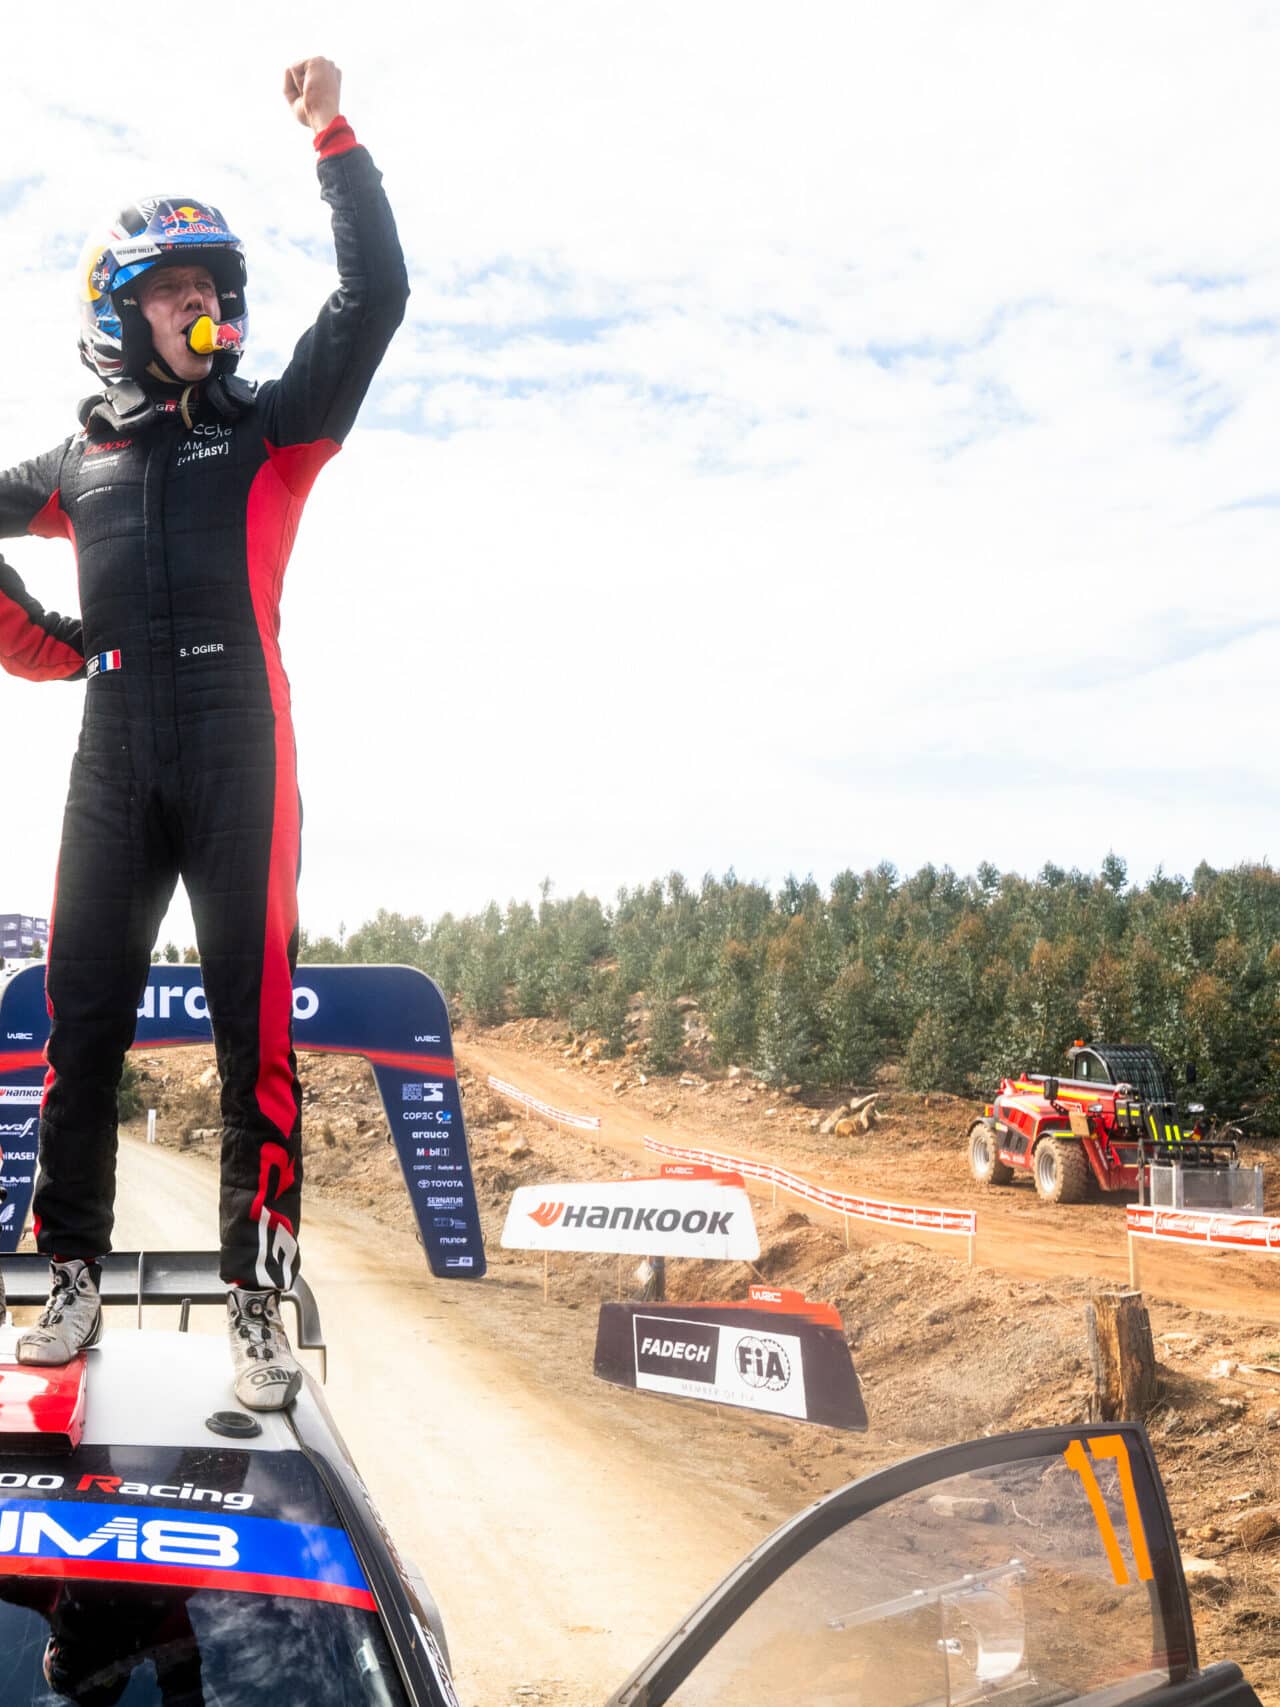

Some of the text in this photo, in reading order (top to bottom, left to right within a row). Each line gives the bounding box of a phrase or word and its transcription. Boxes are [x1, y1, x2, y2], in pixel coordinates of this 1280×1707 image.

[179, 643, 225, 657] S. OGIER
[412, 1130, 449, 1139] arauco
[431, 1179, 464, 1188] TOYOTA
[640, 1337, 711, 1364] FADECH
[1062, 1434, 1154, 1585] 17
